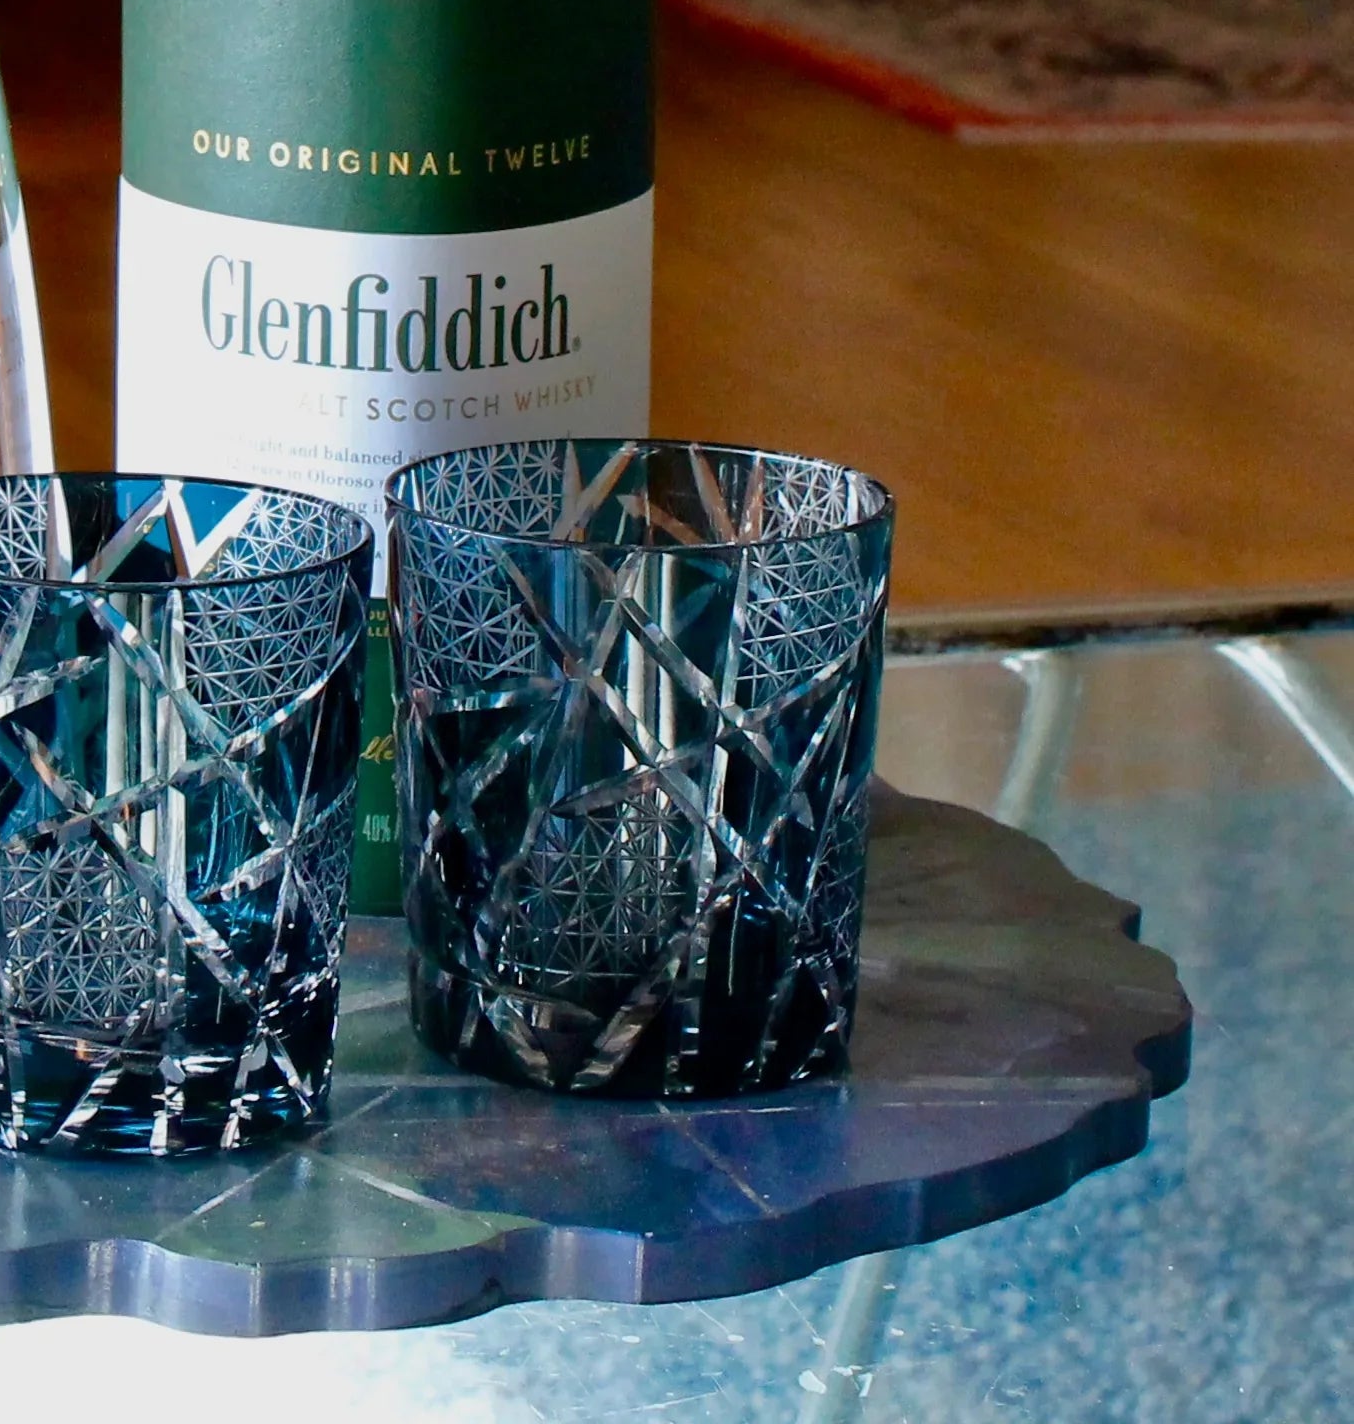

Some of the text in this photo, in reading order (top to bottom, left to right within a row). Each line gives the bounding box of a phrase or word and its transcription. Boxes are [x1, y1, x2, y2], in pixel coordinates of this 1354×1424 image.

[192, 129, 590, 176] OUR ORIGINAL TWELVE
[201, 254, 570, 373] Glenfiddich
[367, 394, 499, 423] SCOTCH
[514, 374, 598, 414] WHISKY
[324, 445, 403, 465] balanced
[307, 469, 375, 489] Oloroso
[362, 814, 391, 843] 40%
